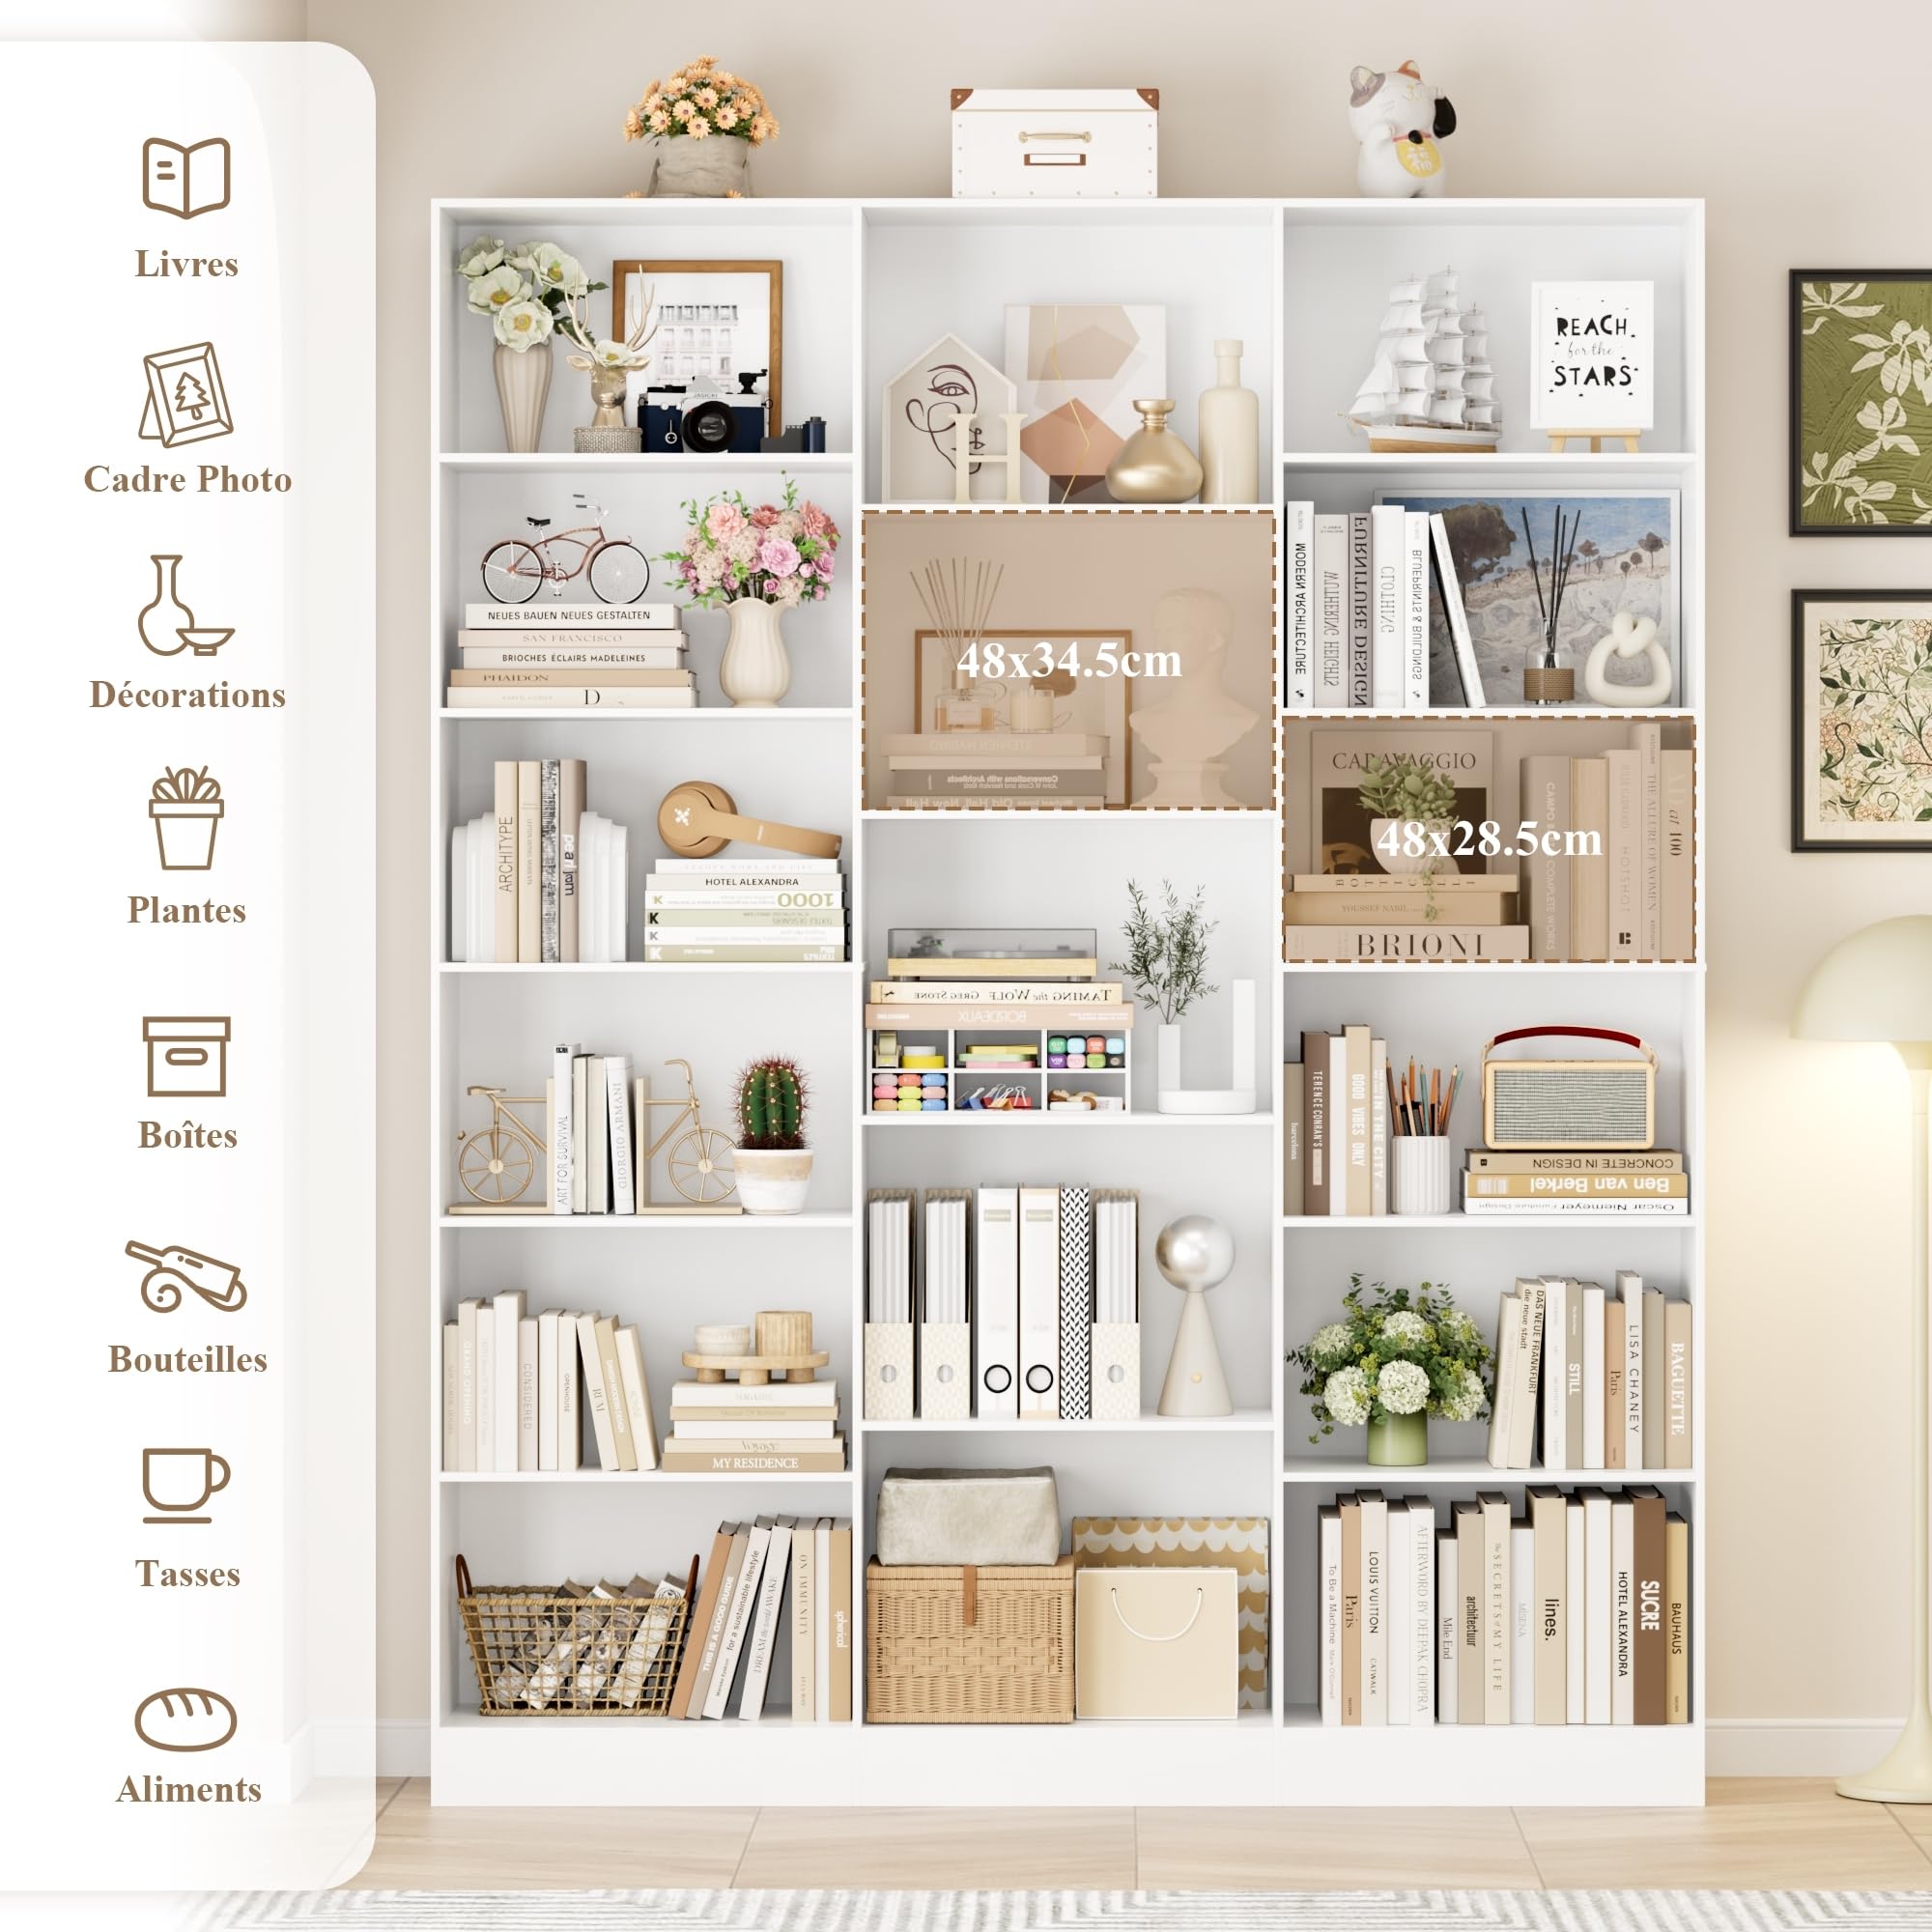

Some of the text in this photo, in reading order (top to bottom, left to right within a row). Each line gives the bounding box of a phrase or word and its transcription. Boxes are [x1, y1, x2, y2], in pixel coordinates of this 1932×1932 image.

[1557, 314, 1627, 336] REACH
[1568, 341, 1614, 358] for the
[1554, 365, 1632, 386] STARS
[488, 611, 650, 620] NEUES BAUEN NEUES GESTALTEN
[502, 652, 645, 663] BRIOCHES ÉCLAIRS MADELEINES
[583, 689, 601, 705] D
[1546, 781, 1556, 820] CAMPO
[1647, 774, 1657, 798] THE
[1647, 800, 1657, 844] ALLURE
[498, 815, 513, 893] ARCHITYPE
[1647, 847, 1657, 862] OF
[1669, 832, 1683, 856] 100
[562, 870, 578, 896] jam
[1647, 866, 1657, 911] WOMEN
[653, 895, 664, 905] K
[777, 893, 835, 908] 1000
[1342, 904, 1379, 913] YOUSSEF
[649, 913, 660, 924] K
[649, 932, 659, 941] K
[1355, 933, 1484, 956] BRIONI
[1313, 1071, 1322, 1148] TERENCE CONRAN'S
[1373, 1095, 1384, 1110] IN
[612, 1083, 627, 1189] GIORGIO ARMANI
[1352, 1074, 1366, 1167] GOOD VIBES ONLY
[1373, 1116, 1384, 1143] THE
[556, 1116, 569, 1205] ART FOR SURVIVAL
[1373, 1148, 1384, 1179] CITY
[1533, 1158, 1674, 1168] CONCRETE IN DESIGN
[1530, 1178, 1669, 1192] Ben van Berkel
[1561, 1202, 1627, 1210] Niemeyer
[1520, 1326, 1528, 1350] stadt
[1528, 1290, 1545, 1394] DAS NEUE FRANKFURT
[1569, 1363, 1580, 1396] STILL
[1610, 1370, 1622, 1396] Paris
[1630, 1324, 1639, 1434] LISA CHANEY
[1671, 1343, 1685, 1435] BAGUETTE
[524, 1364, 533, 1430] CONSIDERED
[713, 1458, 799, 1469] MY RESIDENCE
[1328, 1564, 1337, 1576] To
[1328, 1578, 1337, 1591] Be
[726, 1642, 735, 1651] for
[734, 1583, 751, 1630] sustainable
[746, 1550, 759, 1582] lifestyle
[799, 1554, 808, 1635] ON IMMUNITY
[1369, 1551, 1379, 1634] LOUIS VUITTON
[1492, 1554, 1502, 1619] SECRETS
[1345, 1595, 1358, 1629] Paris
[1417, 1525, 1429, 1713] AFTERWORD BY DEEPAK CHOPRA
[1466, 1596, 1477, 1647] architectuur
[1545, 1599, 1559, 1641] lines.
[1640, 1580, 1661, 1631] SUCRE
[703, 1651, 714, 1671] THIS
[713, 1605, 725, 1633] GOOD
[753, 1638, 766, 1673] DREAM
[766, 1577, 778, 1606] AWAKE
[1328, 1604, 1337, 1644] Machine
[1443, 1617, 1453, 1660] Mile End
[1492, 1630, 1502, 1650] MY
[1618, 1572, 1628, 1677] HOTEL ALEXANDRA
[1672, 1603, 1682, 1655] BAUHAUS
[1492, 1659, 1502, 1691] LIFE
